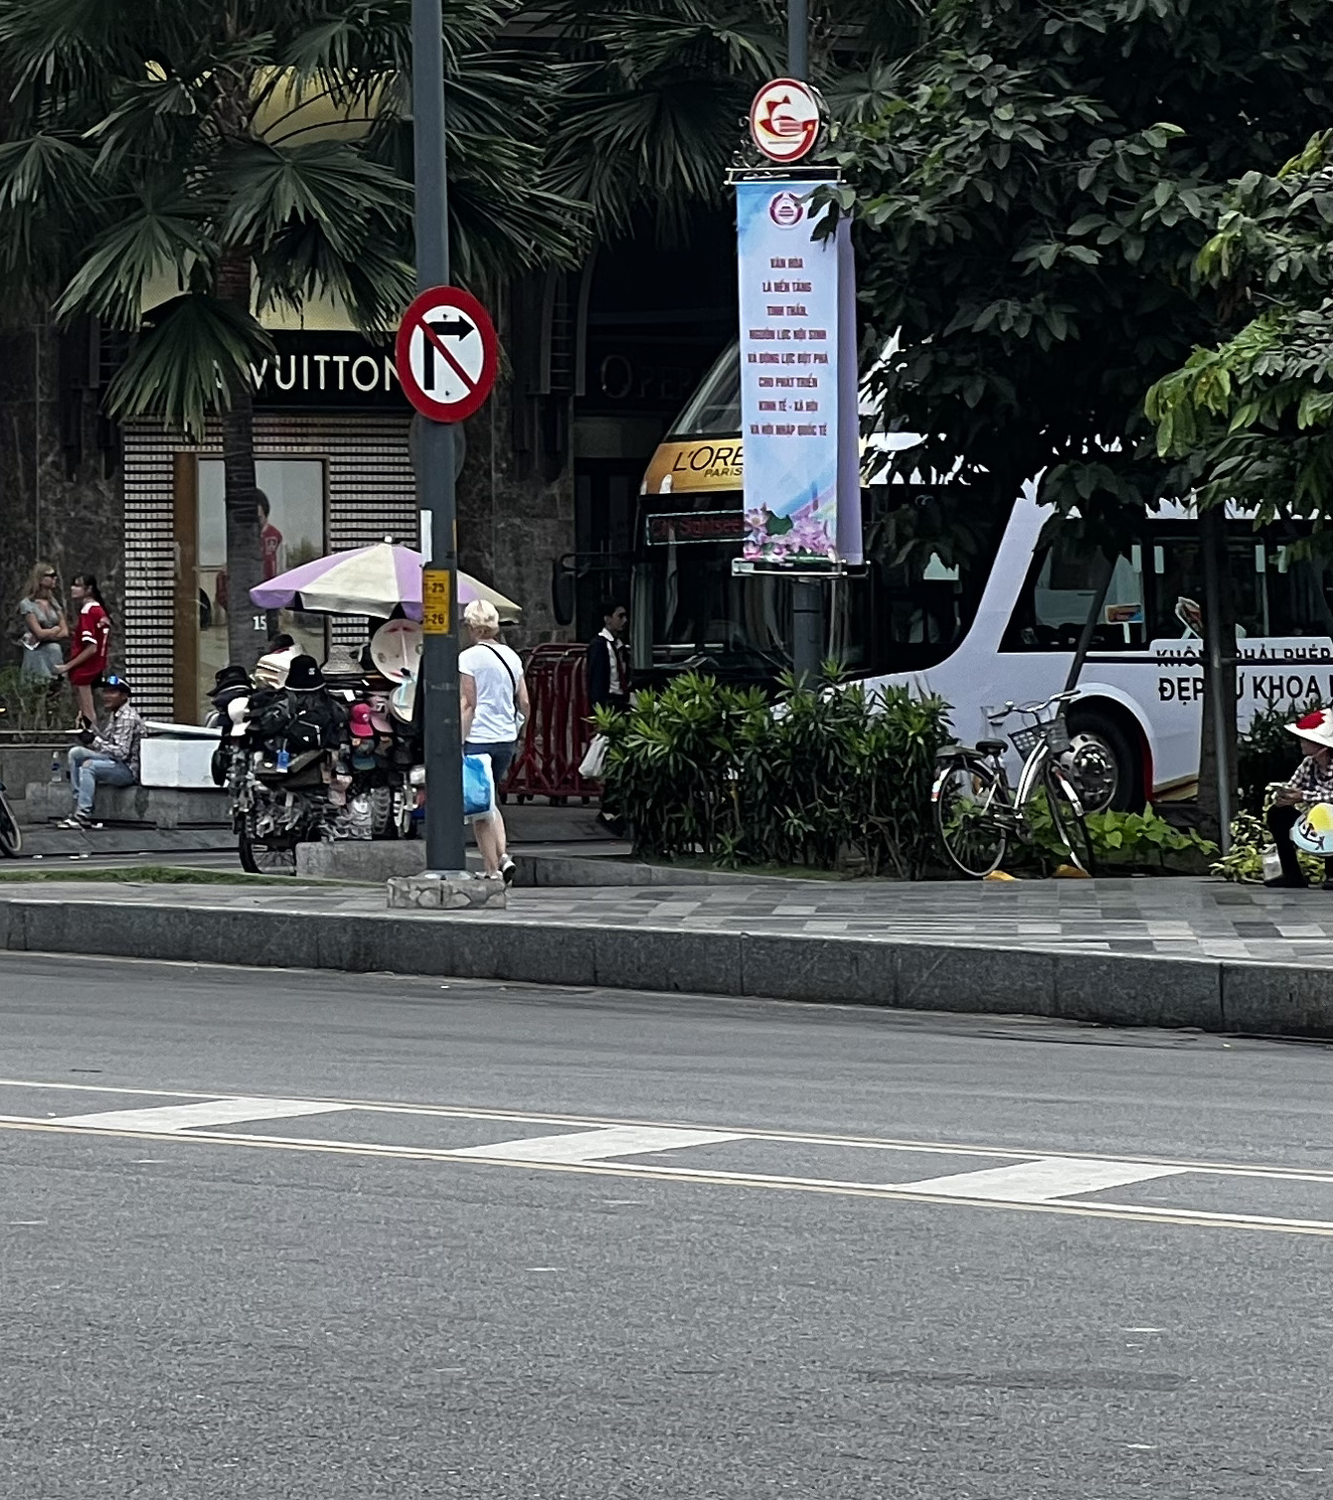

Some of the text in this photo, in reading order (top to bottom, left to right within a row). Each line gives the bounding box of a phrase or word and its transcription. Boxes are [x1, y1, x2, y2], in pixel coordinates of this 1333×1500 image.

[672, 445, 744, 472] L'ORE
[704, 467, 743, 478] PARIS
[252, 615, 268, 631] 15
[1156, 645, 1203, 667] KHÔ
[1159, 677, 1205, 706] ĐẸP
[1252, 675, 1321, 700] KHOA
